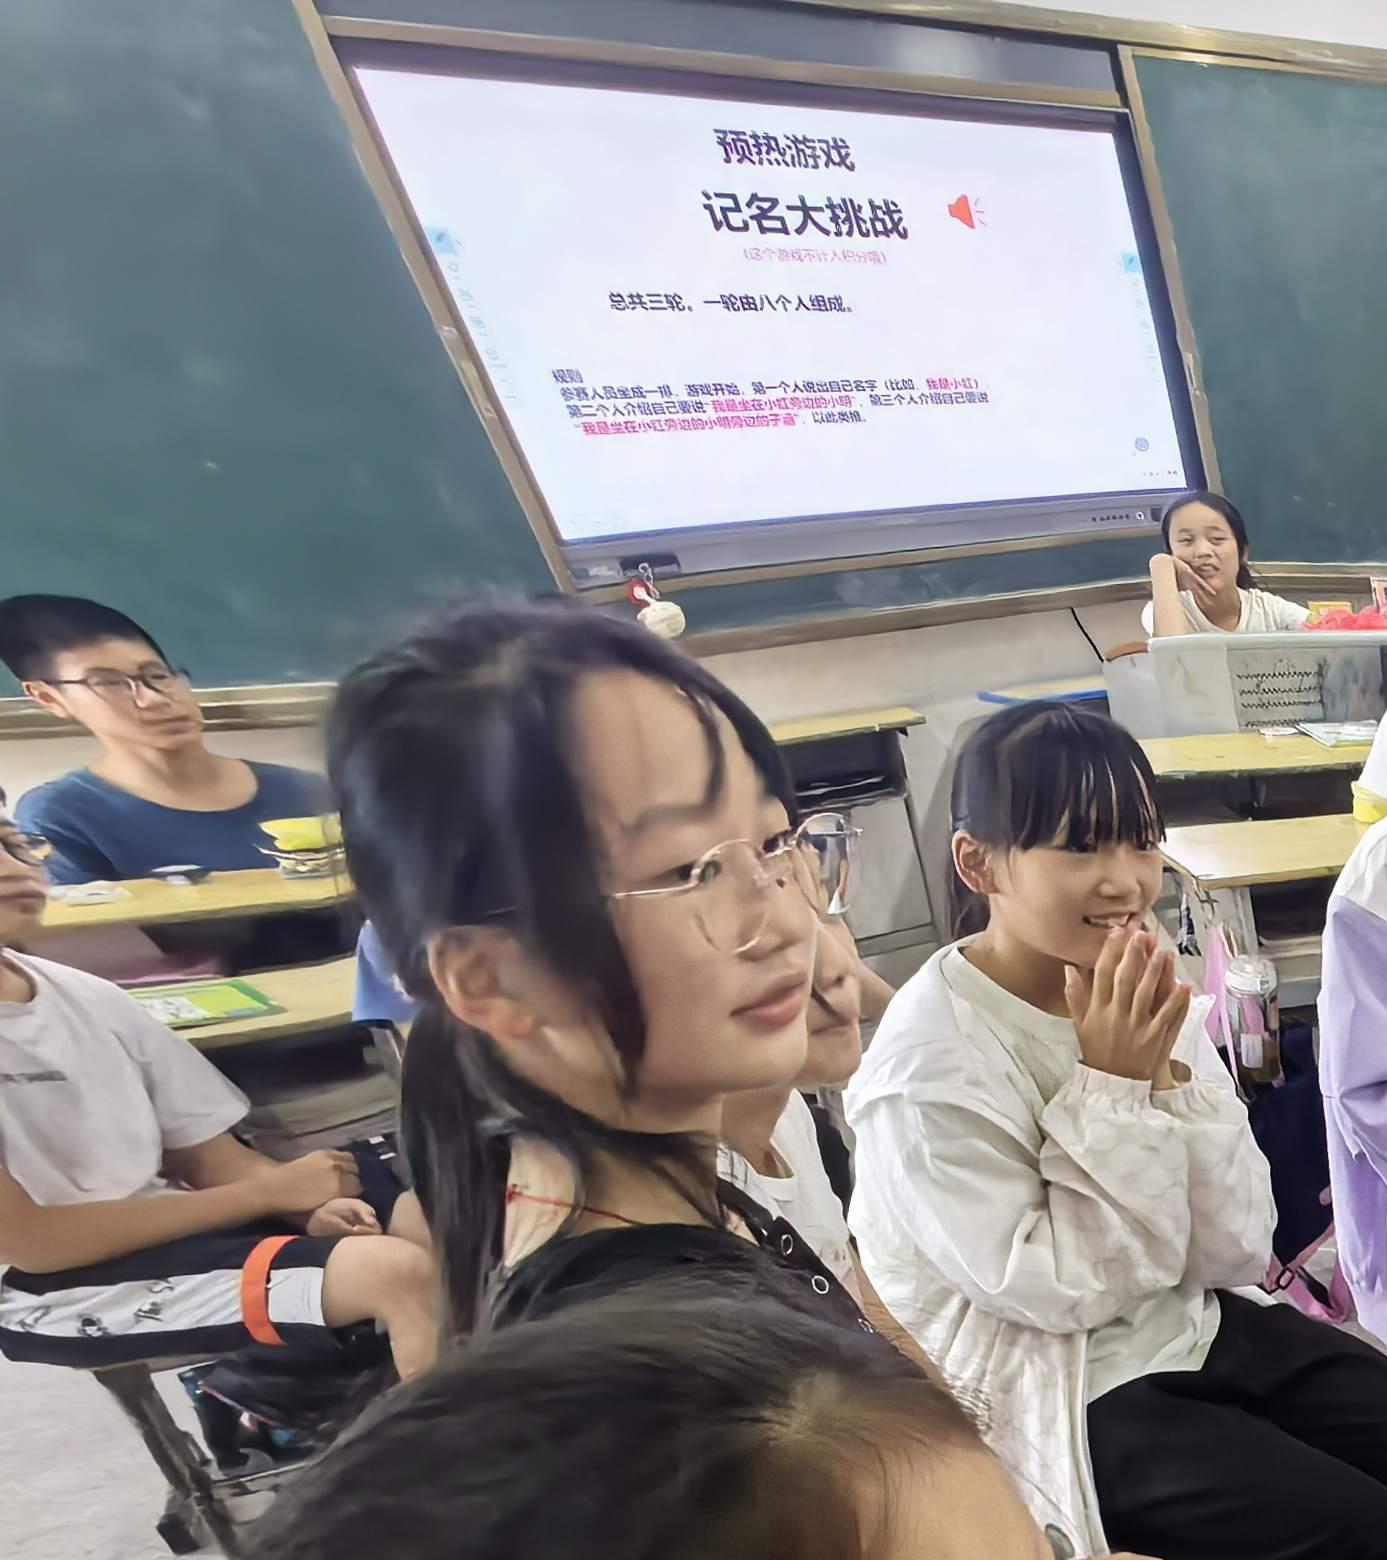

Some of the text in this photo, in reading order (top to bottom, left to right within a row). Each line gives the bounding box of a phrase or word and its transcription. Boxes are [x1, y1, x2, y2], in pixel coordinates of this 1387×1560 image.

[713, 128, 856, 172] 预热游戏
[701, 190, 908, 240] 记名大挑战
